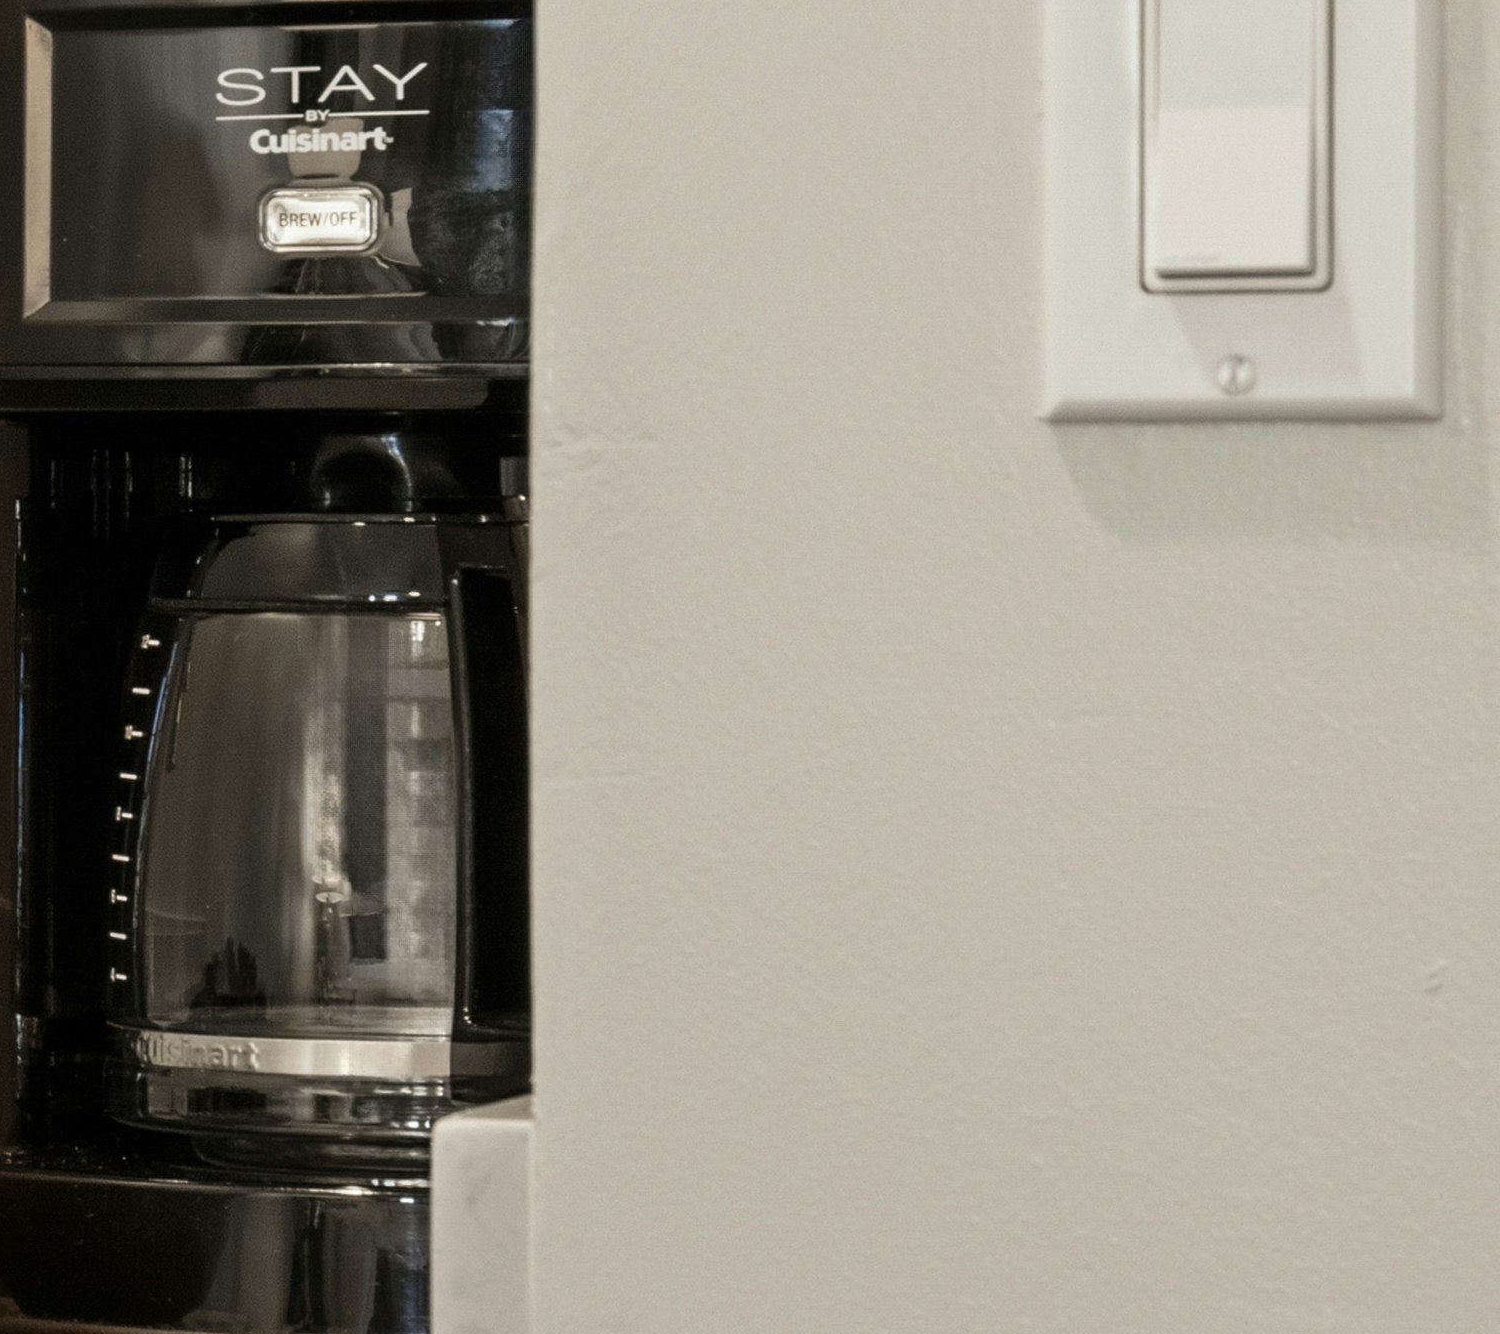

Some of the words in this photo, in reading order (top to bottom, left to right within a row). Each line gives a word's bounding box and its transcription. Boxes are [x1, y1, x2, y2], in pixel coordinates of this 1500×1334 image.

[215, 62, 428, 106] STAY
[305, 109, 330, 122] BY
[250, 126, 388, 154] Cuisinart
[278, 210, 358, 228] BREW/OFF
